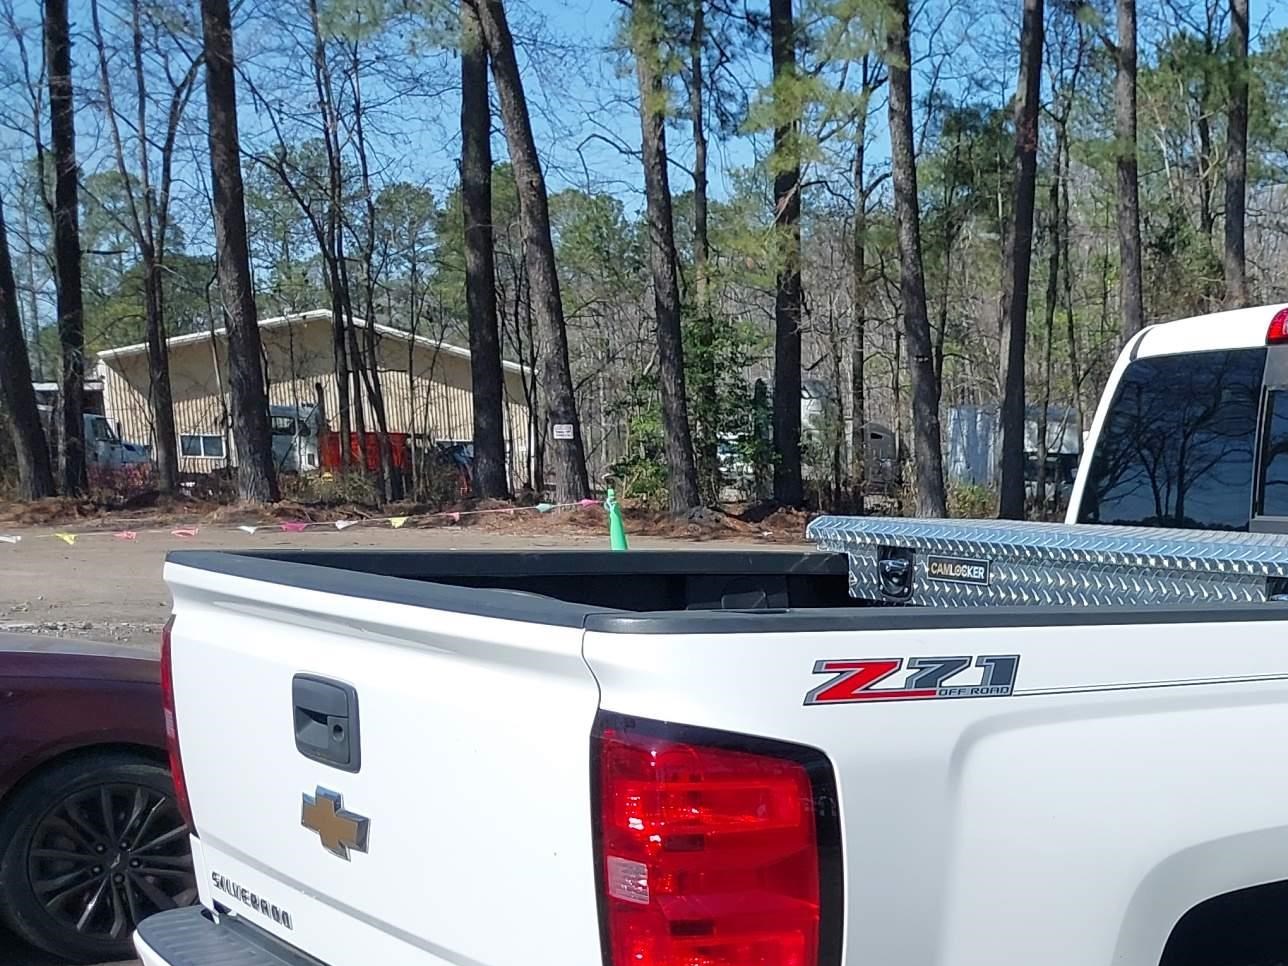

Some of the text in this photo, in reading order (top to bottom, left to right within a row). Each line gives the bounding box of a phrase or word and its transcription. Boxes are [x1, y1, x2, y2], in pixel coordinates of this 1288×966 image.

[930, 562, 985, 580] CAMLOCKER
[803, 655, 1020, 706] Z71
[938, 686, 1009, 697] OFF ROAD
[211, 871, 294, 931] SILVERADO
